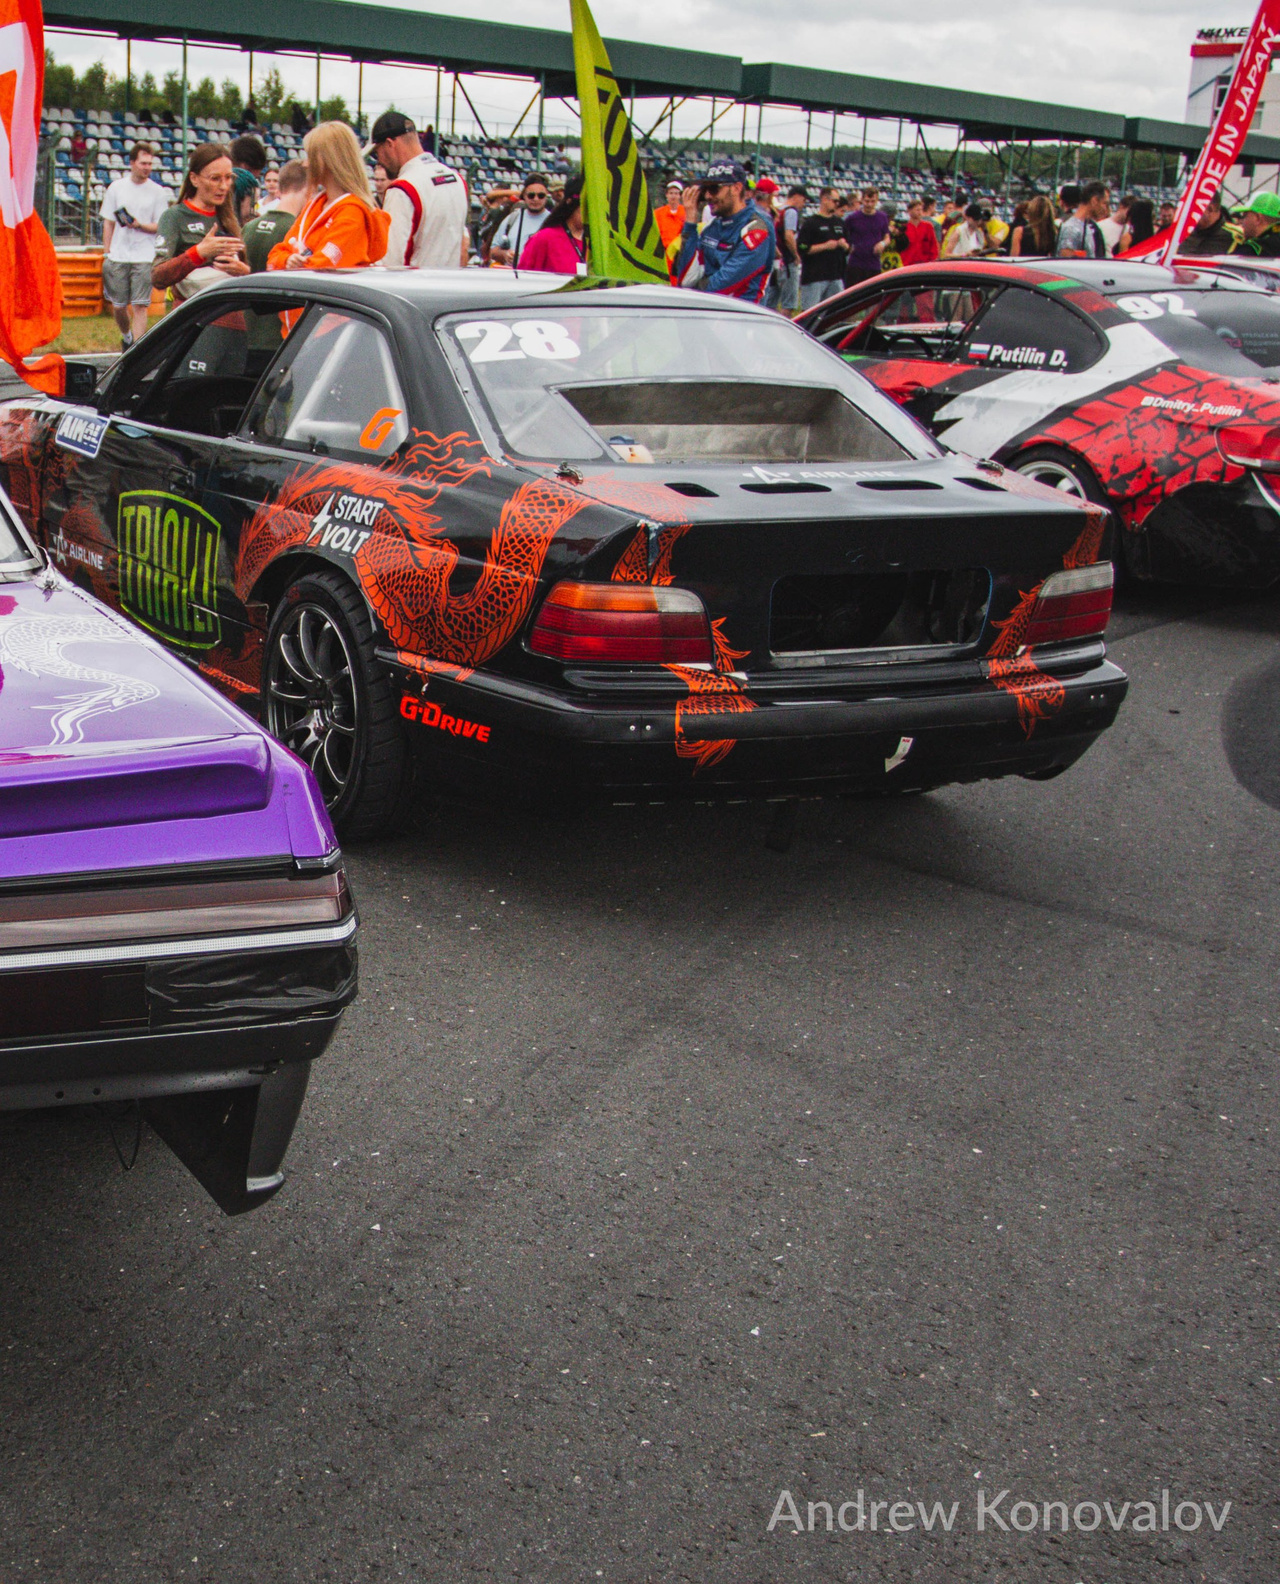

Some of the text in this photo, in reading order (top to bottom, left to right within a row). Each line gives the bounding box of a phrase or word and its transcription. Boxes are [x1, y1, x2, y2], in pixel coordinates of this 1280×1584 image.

[1216, 124, 1239, 157] IN
[1234, 26, 1277, 122] JAPAN
[257, 220, 276, 230] CR
[1117, 292, 1197, 320] 92
[455, 320, 581, 363] 28
[188, 360, 207, 372] CR
[989, 345, 1068, 368] Putilin D.
[334, 495, 384, 526] START
[320, 523, 371, 554] VOLT
[69, 543, 104, 571] AIRLINE
